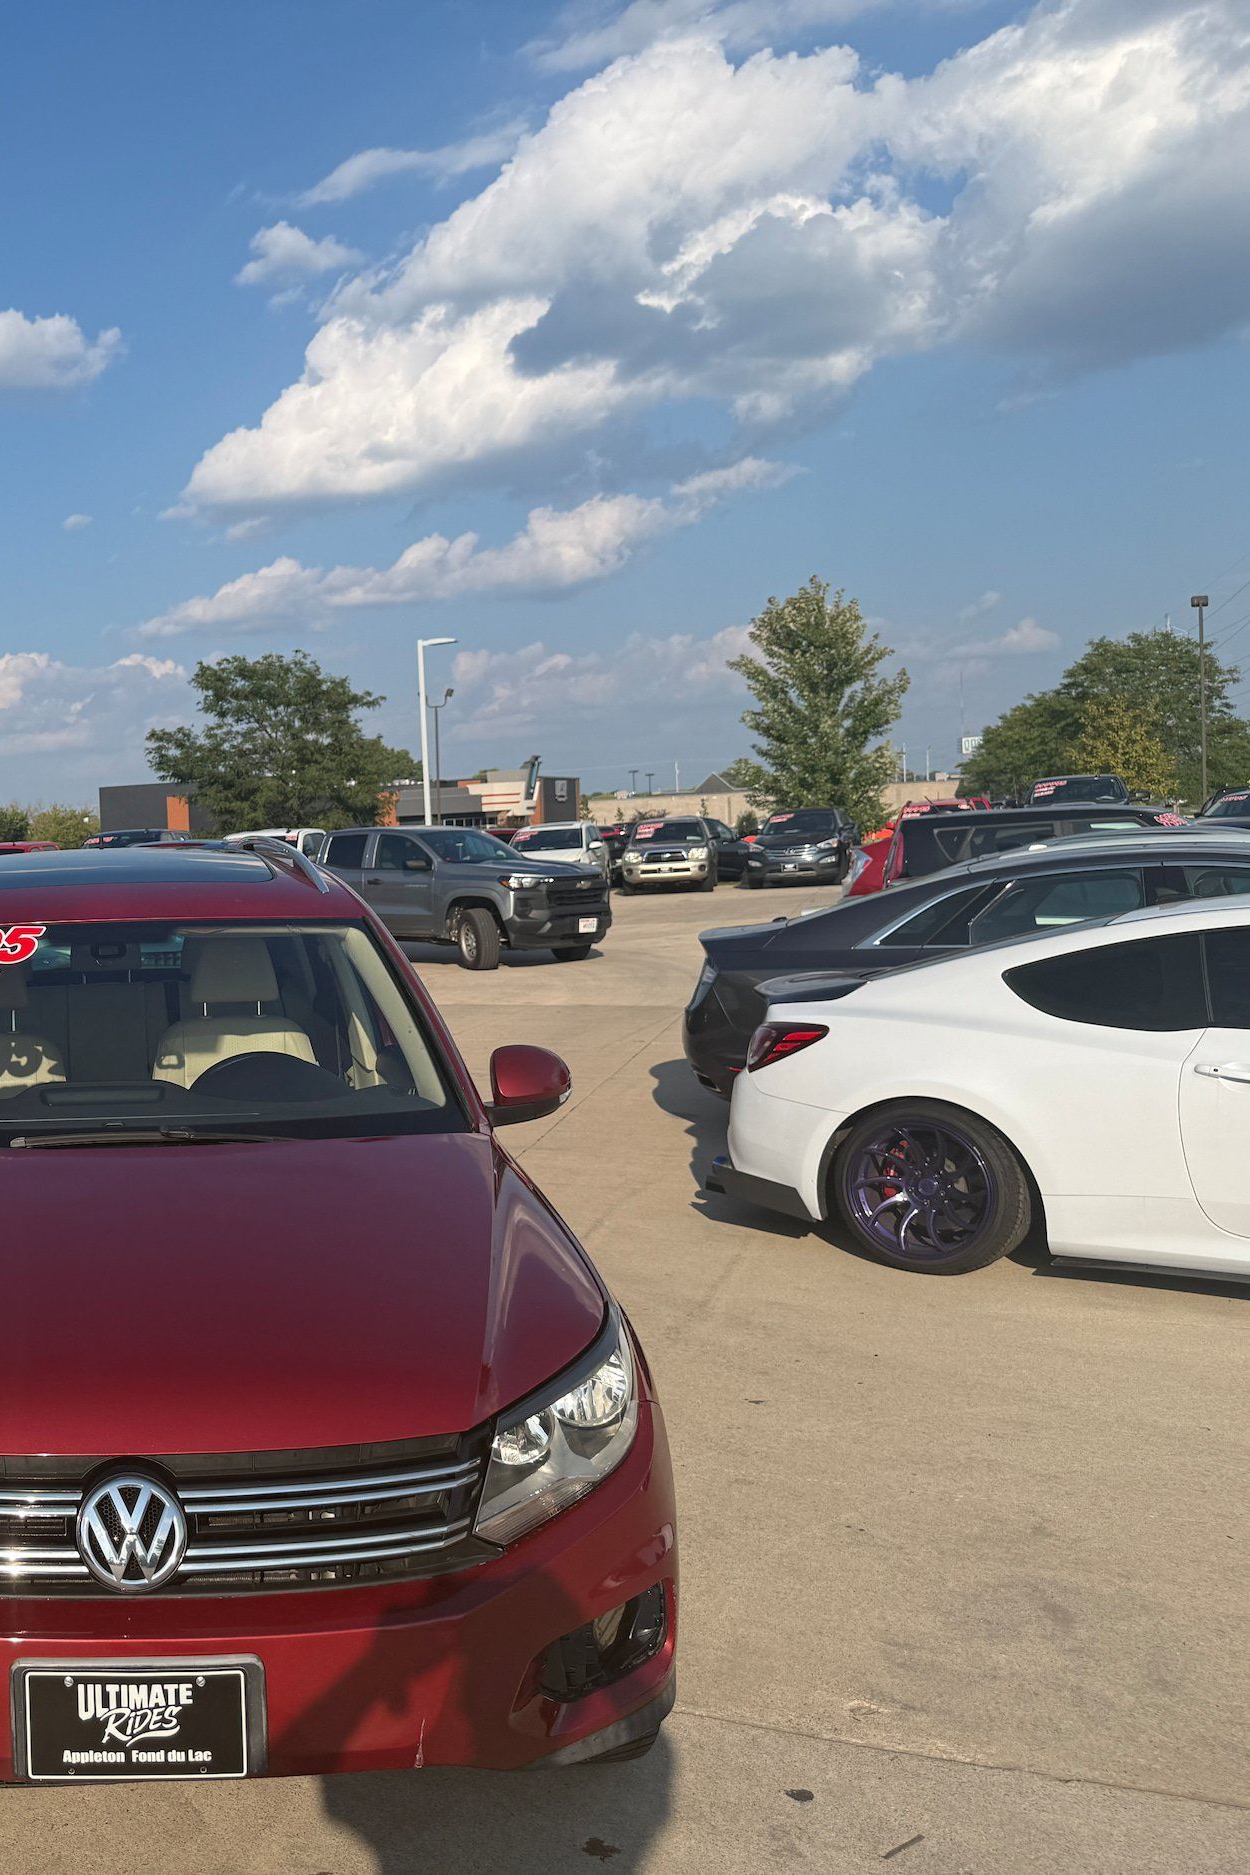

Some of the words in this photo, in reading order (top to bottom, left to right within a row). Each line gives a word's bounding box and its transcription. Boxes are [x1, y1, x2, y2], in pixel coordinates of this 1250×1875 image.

[77, 1471, 188, 1593] VW
[77, 1682, 193, 1721] ULTIMATE
[63, 1750, 125, 1764] Appleton
[131, 1749, 166, 1762] Fond
[167, 1749, 186, 1762] du
[188, 1749, 212, 1762] Lac
